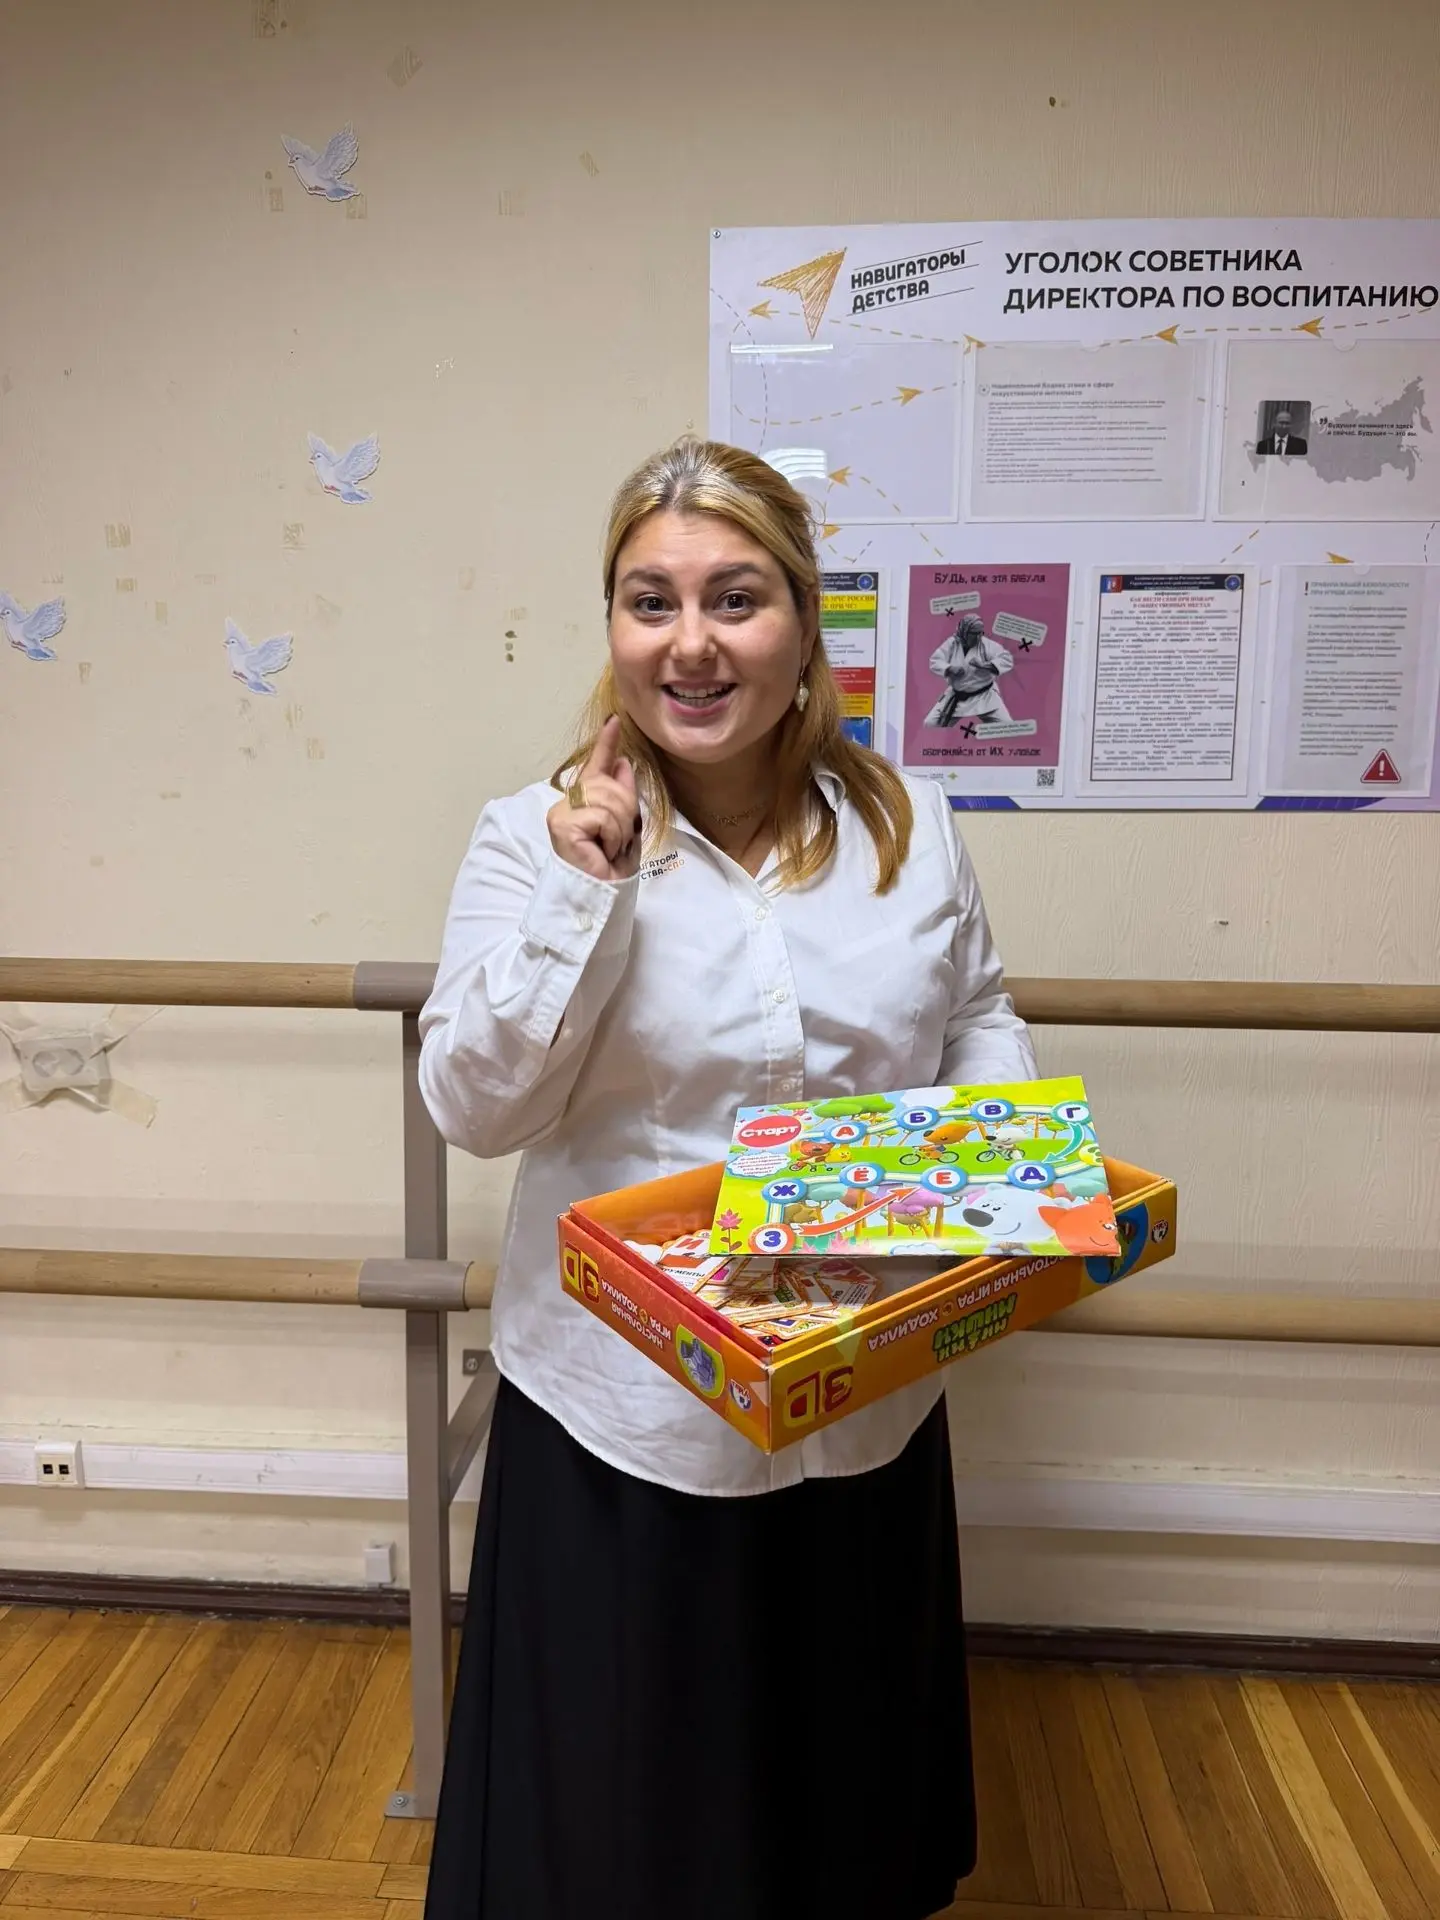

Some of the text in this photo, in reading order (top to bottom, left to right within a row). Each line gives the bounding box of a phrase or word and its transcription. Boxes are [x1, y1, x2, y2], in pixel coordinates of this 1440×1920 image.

[851, 249, 965, 289] НАВИГАТОРЫ
[1005, 249, 1303, 274] УГОЛОК СОВЕТНИКА
[852, 279, 930, 314] ДЕТСТВА
[1003, 284, 1439, 314] ДИРЕКТОРА ПО ВОСПИТАНИЮ
[934, 573, 968, 585] БУДЬ,
[990, 746, 1004, 757] ИХ
[836, 1104, 1081, 1138] А Б В Г
[772, 1166, 1046, 1197] Ж Ё Е Д
[601, 1278, 671, 1341] ИГРА ХОДИЛКА
[868, 1256, 1063, 1352] СТОЛЬНАЯ ИГРА ХОДИЛКА
[611, 1301, 664, 1349] НАСТОЛЬНАЯ
